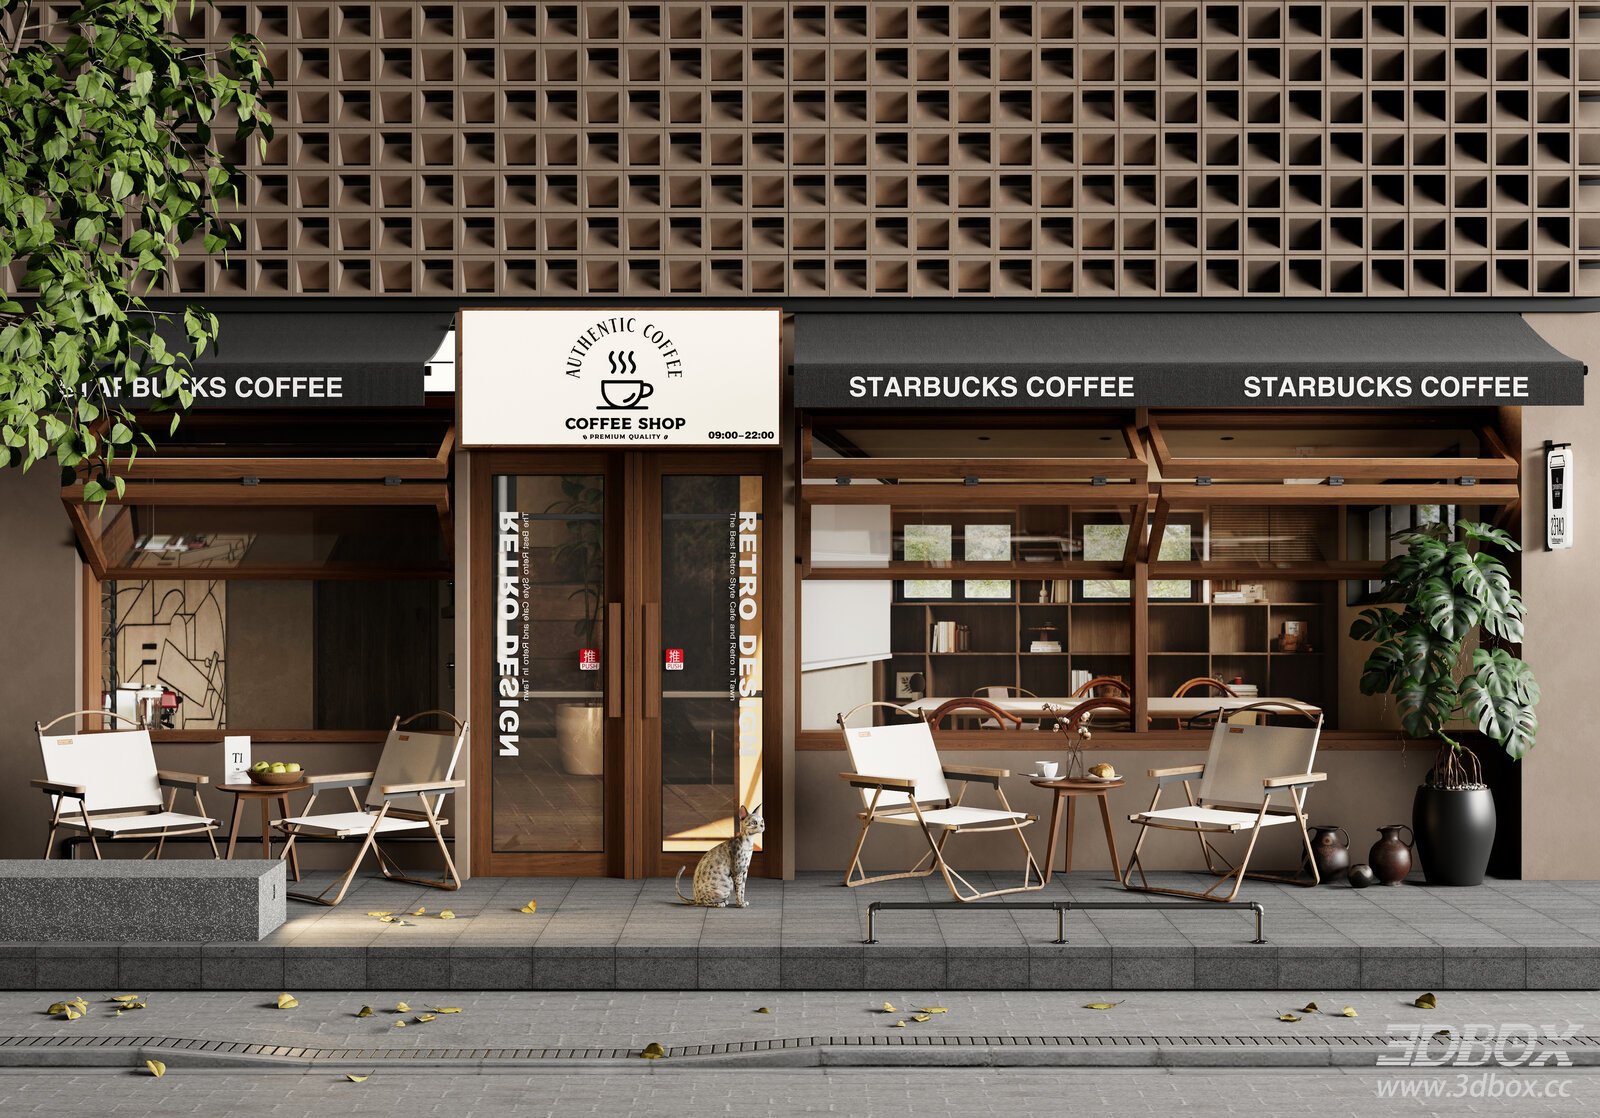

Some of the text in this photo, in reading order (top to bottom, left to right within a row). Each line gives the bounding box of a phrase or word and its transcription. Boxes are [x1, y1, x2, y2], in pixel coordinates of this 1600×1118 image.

[565, 317, 683, 379] AUTHENTIC COFFEE
[234, 376, 342, 398] COFFEE
[849, 376, 1135, 398] STARBUCKS COFFEE
[1243, 376, 1529, 398] STARBUCKS COFFEE
[565, 417, 686, 430] COFFEE SHOP
[628, 433, 661, 441] QUALITY
[729, 511, 737, 528] The
[729, 531, 737, 549] Best
[729, 552, 737, 576] Retro
[728, 578, 737, 599] Style
[729, 602, 737, 622] Cafe
[729, 624, 737, 640] and
[738, 512, 757, 757] RETRO DESIGN
[584, 650, 595, 663] 推
[669, 650, 680, 663] 推
[729, 643, 737, 666] Retro
[729, 668, 737, 676] In
